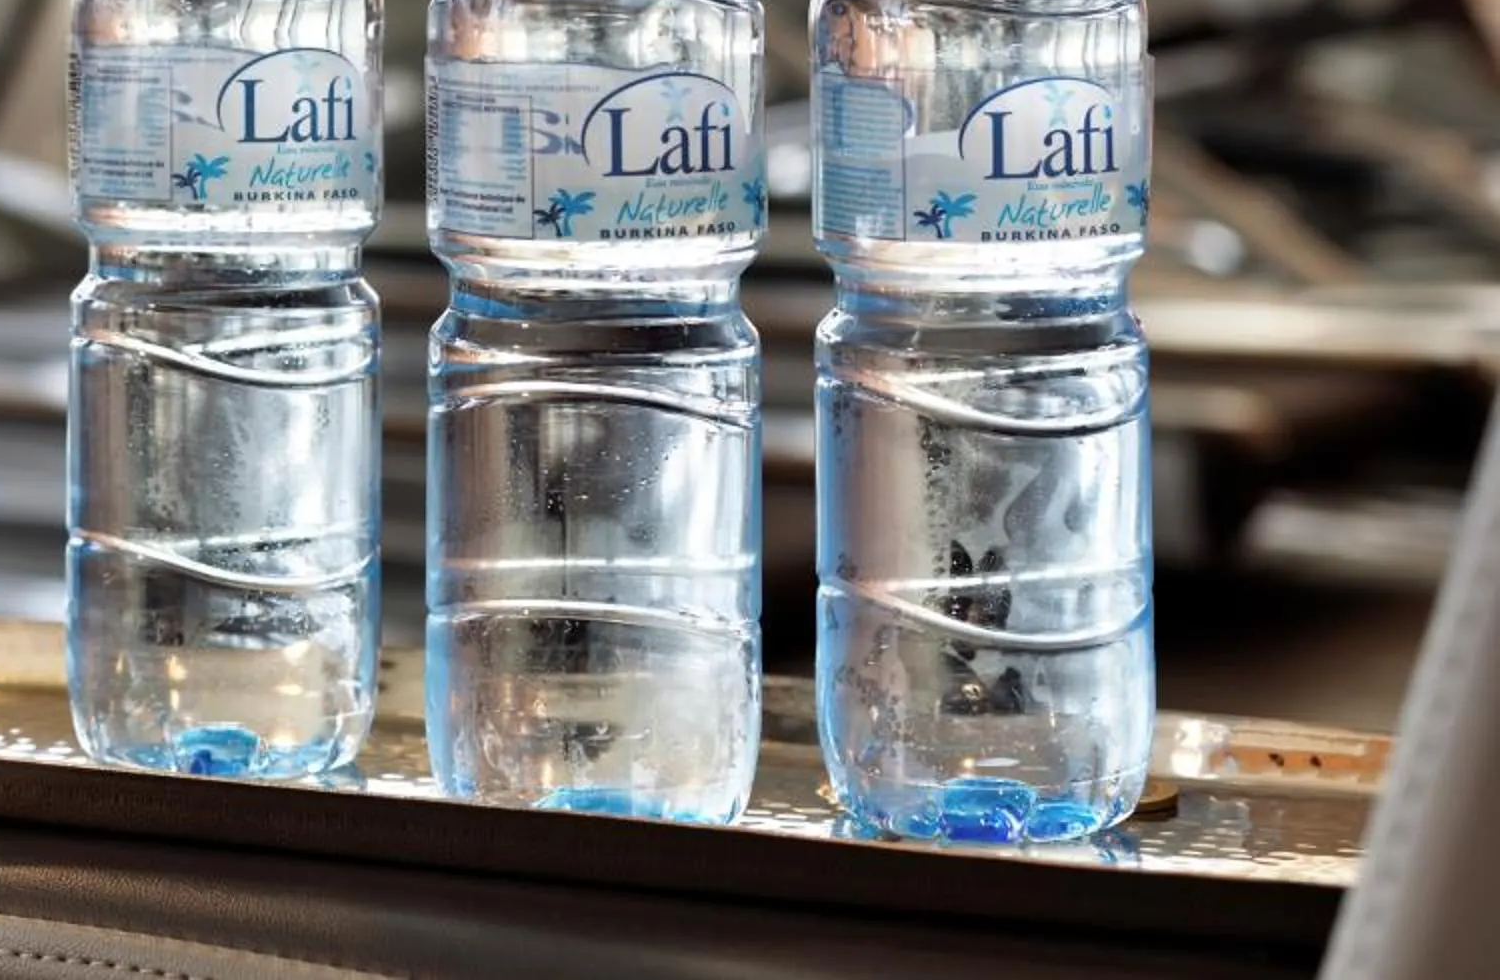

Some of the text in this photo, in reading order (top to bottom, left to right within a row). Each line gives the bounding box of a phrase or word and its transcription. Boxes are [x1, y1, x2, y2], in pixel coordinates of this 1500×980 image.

[238, 75, 357, 143] Lafi
[603, 102, 735, 177] Lafi
[984, 105, 1119, 179] Lafi
[234, 188, 359, 201] BURKINA FASO
[617, 181, 729, 224] Naturelle
[998, 183, 1111, 228] Naturelle
[600, 222, 736, 240] BURKINA FASO
[982, 223, 1121, 242] BURKINA FASO
